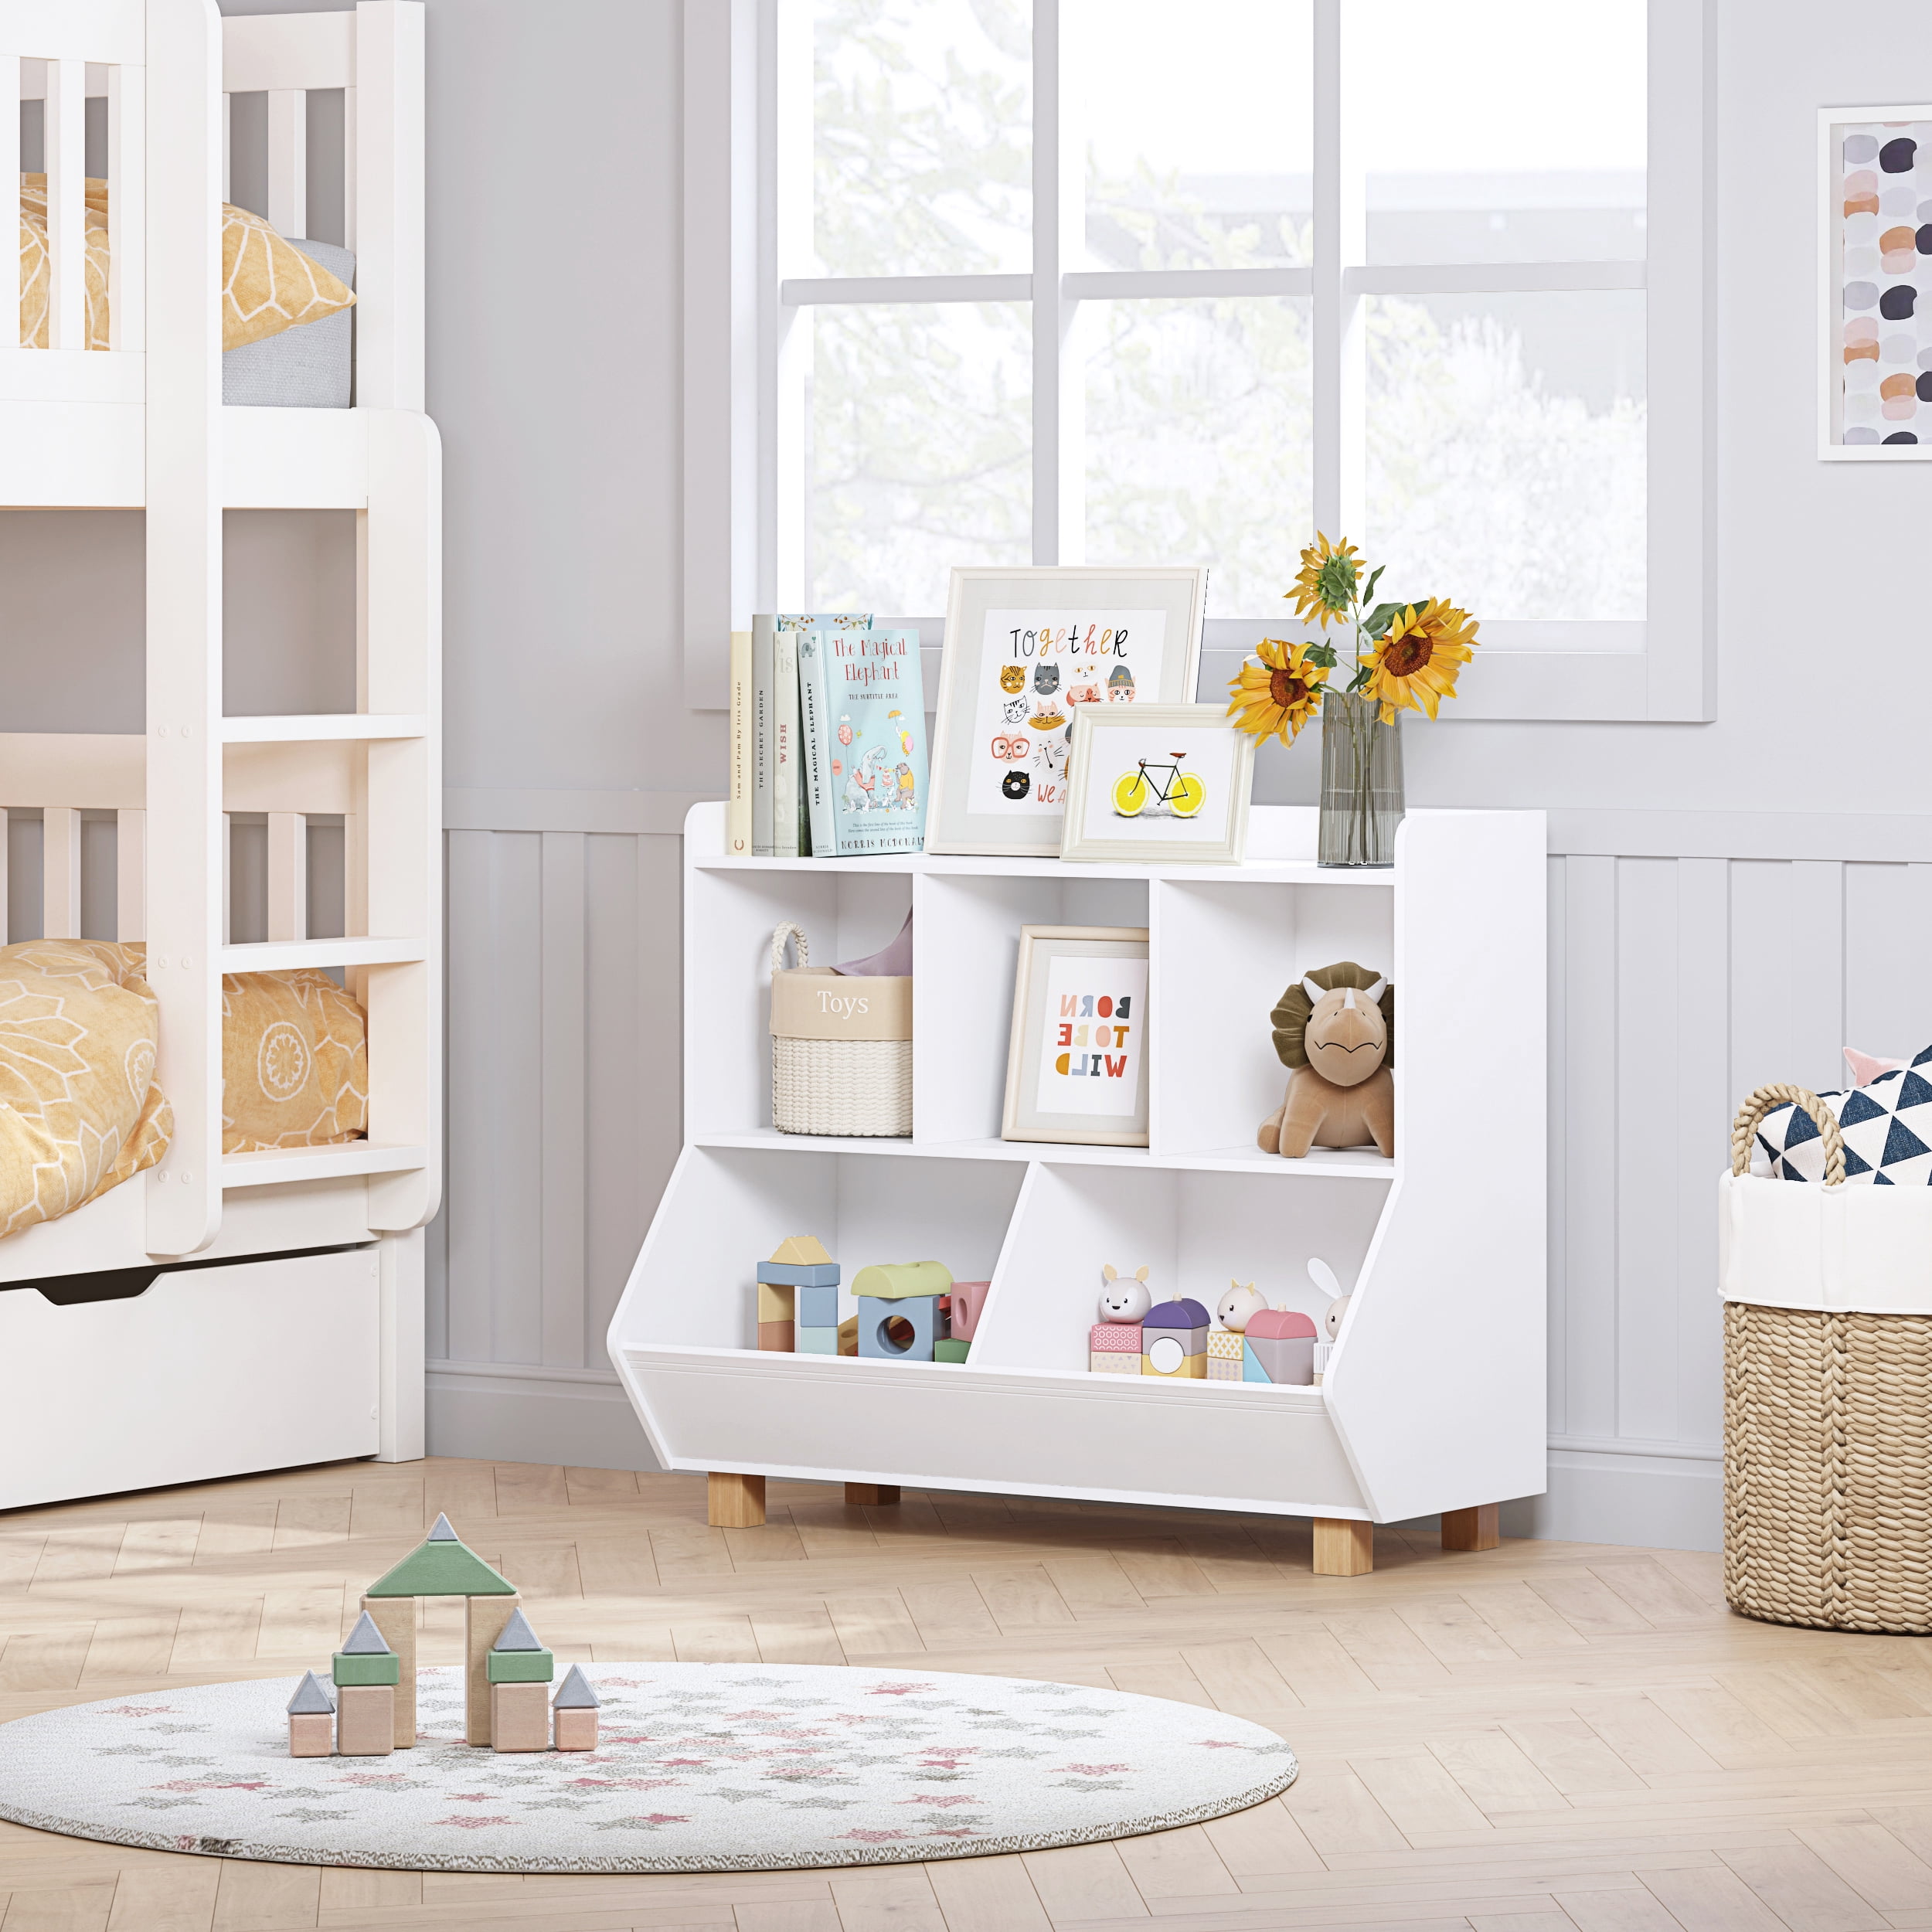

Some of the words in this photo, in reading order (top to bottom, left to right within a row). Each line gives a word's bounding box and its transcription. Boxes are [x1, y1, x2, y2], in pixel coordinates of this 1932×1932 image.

[832, 638, 855, 657] The
[861, 638, 908, 662] Magical
[844, 661, 900, 686] Elephant
[807, 682, 815, 733] ELEPHANT
[1038, 784, 1056, 803] We
[841, 839, 875, 849] NORRIS
[817, 990, 869, 1020] Toys
